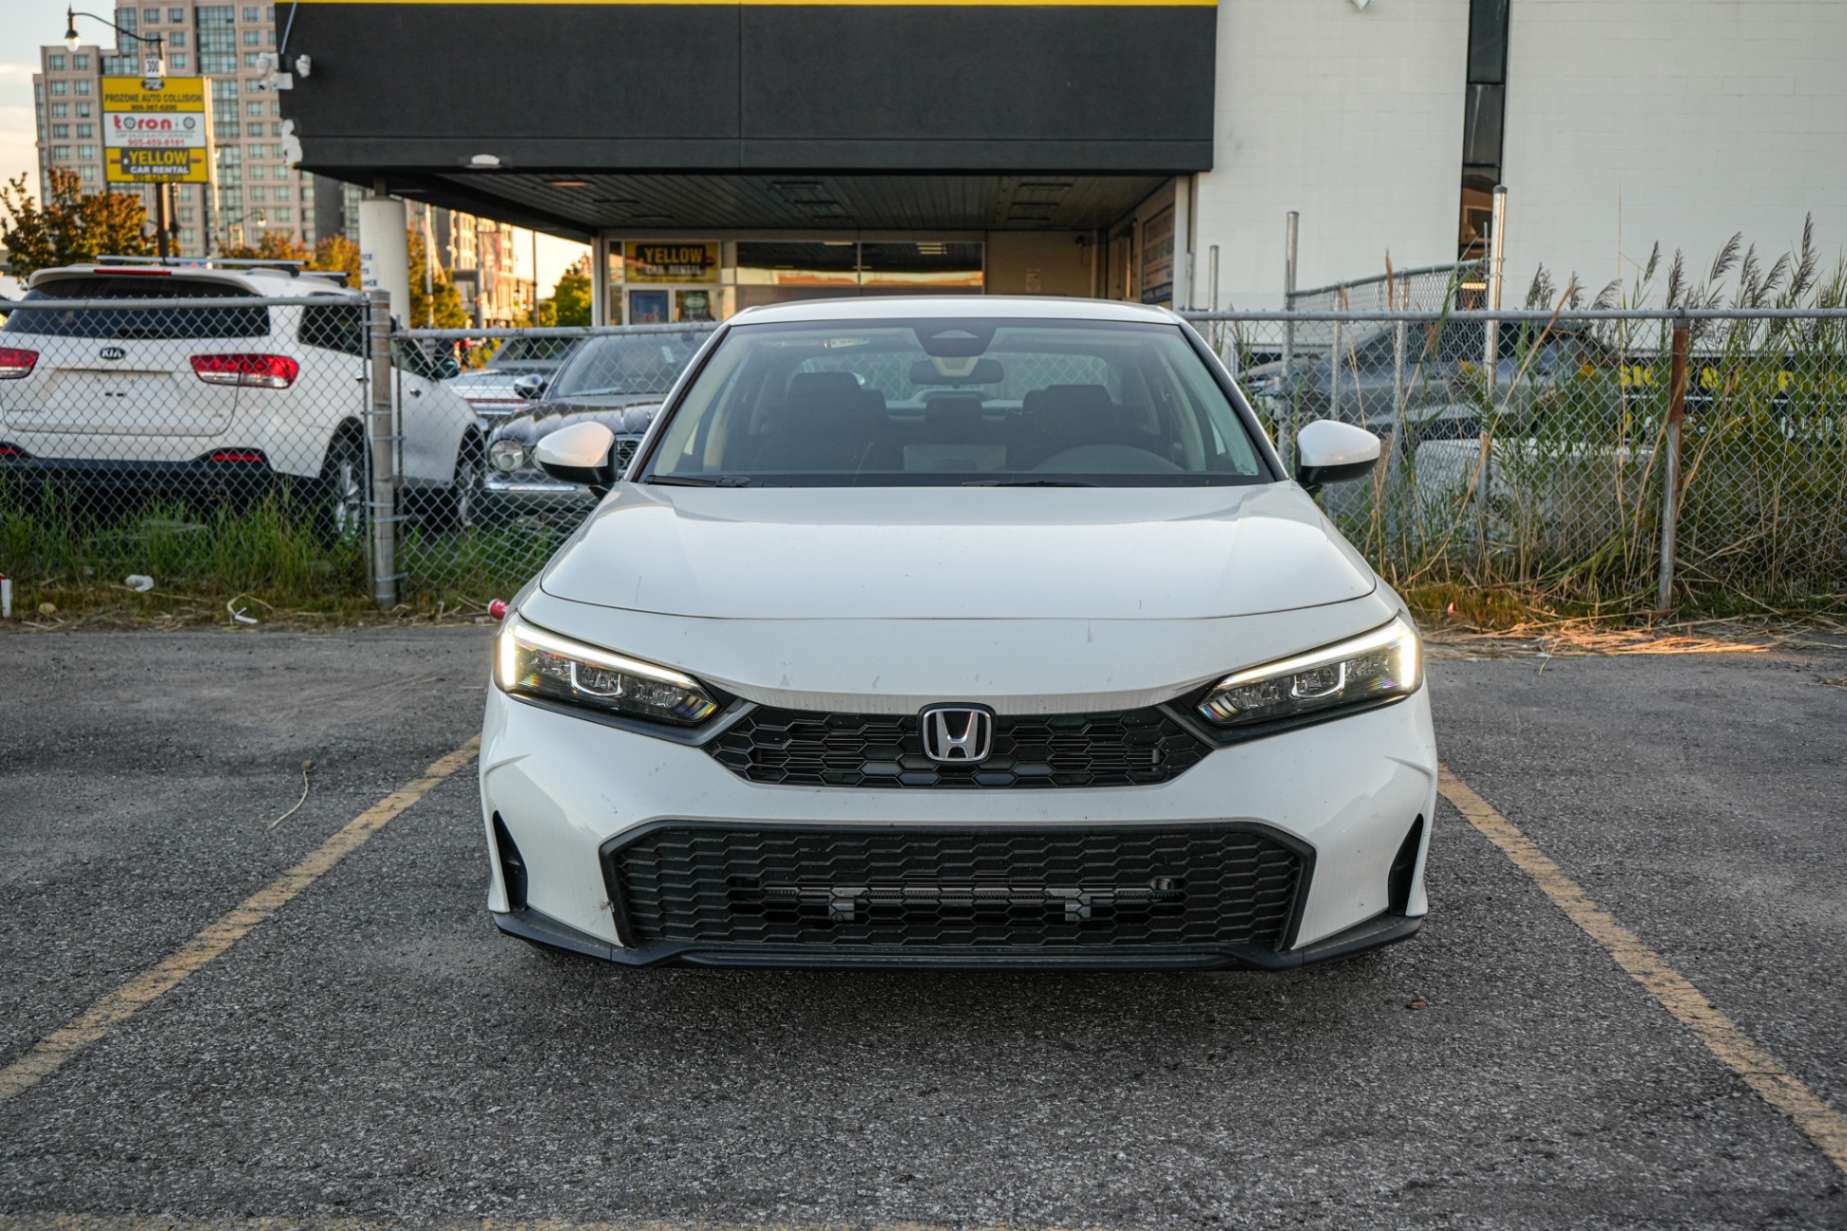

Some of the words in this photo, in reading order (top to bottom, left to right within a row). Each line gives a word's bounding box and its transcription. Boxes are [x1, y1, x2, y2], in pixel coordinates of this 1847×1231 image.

[142, 93, 161, 102] AUTO
[163, 93, 203, 102] COLLISION
[129, 150, 188, 165] YELLOW
[130, 165, 151, 174] CAR
[152, 165, 189, 174] RENTAL
[644, 247, 704, 264] YELLOW
[102, 350, 122, 358] KIA
